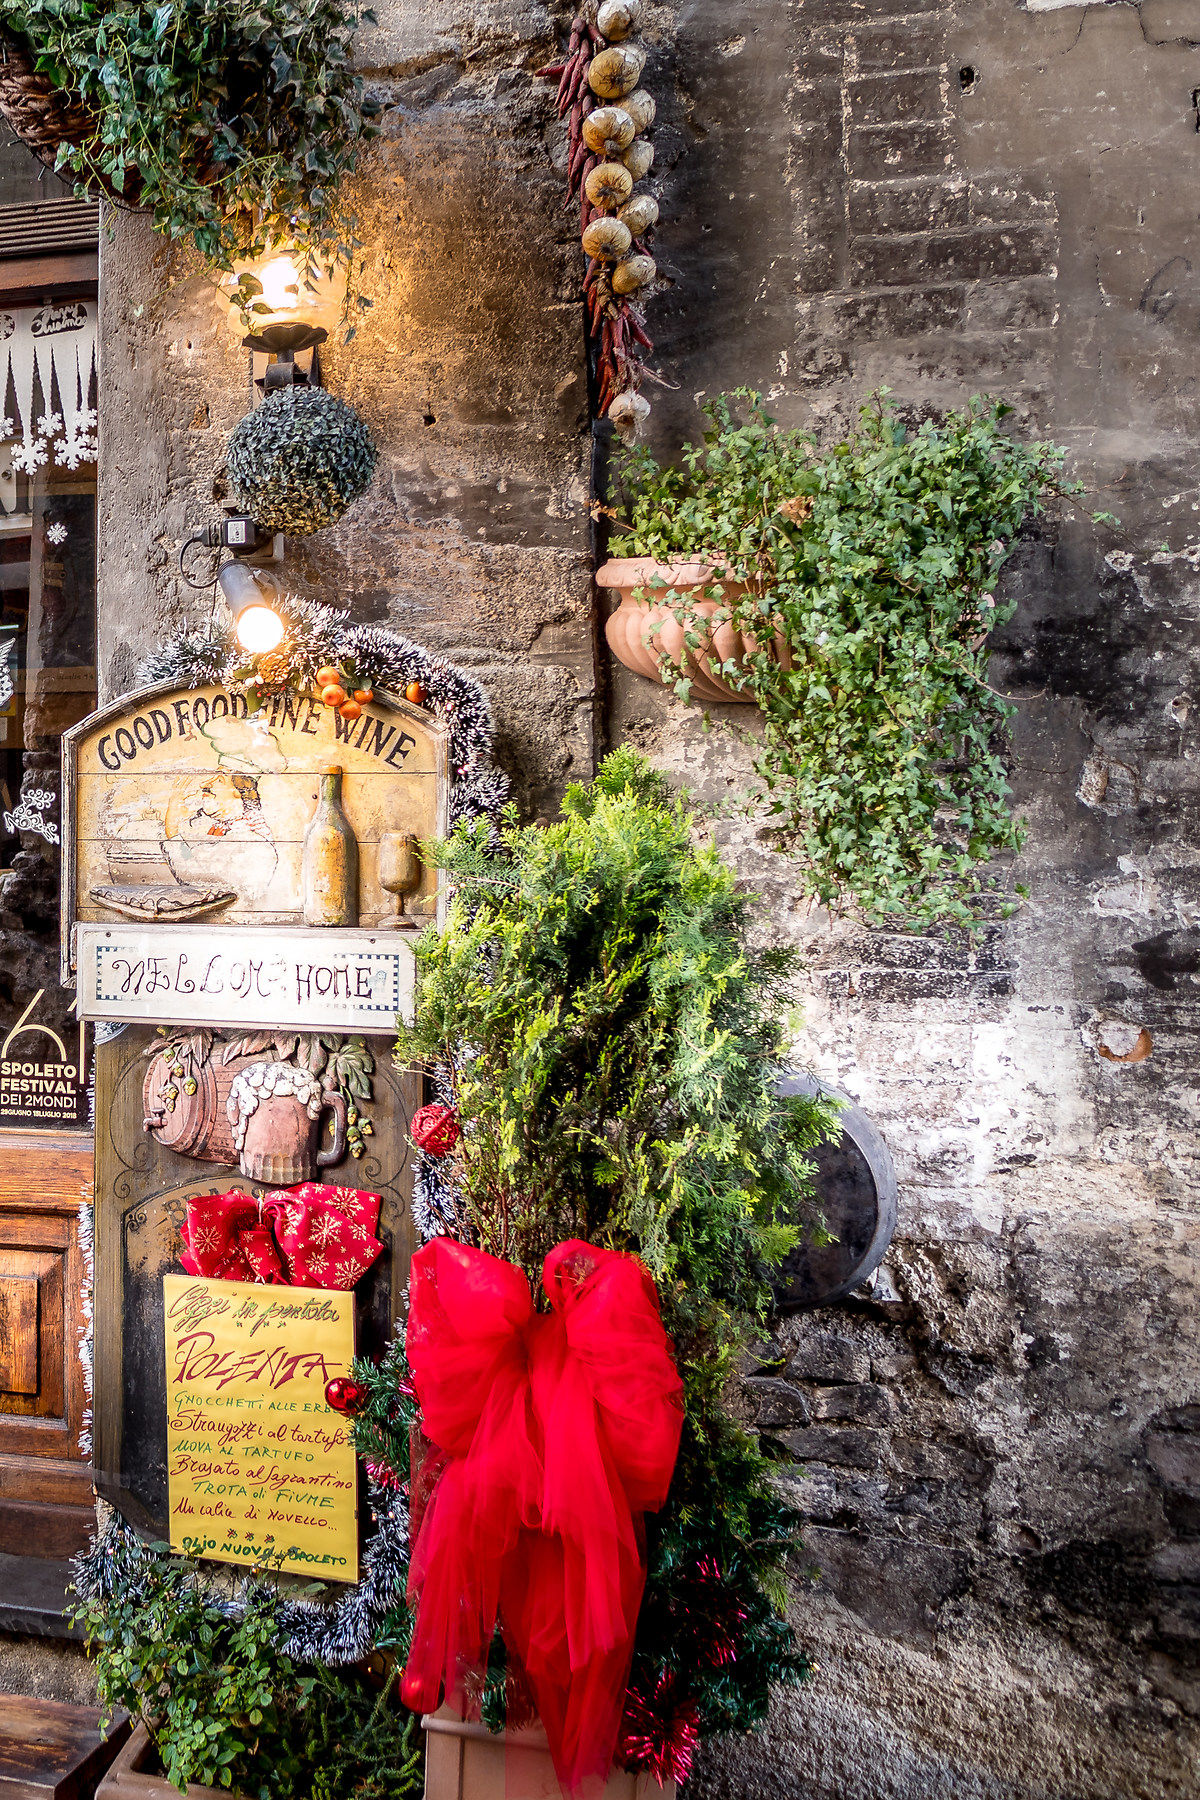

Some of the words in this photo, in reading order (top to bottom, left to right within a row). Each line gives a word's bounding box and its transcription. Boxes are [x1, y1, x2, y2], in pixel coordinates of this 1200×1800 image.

[98, 709, 172, 770] GOOD
[171, 693, 248, 736] FOOD
[266, 696, 325, 735] INE
[334, 706, 416, 770] WINE
[296, 964, 372, 1004] HOME
[1, 1061, 77, 1079] SPOLETO
[1, 1078, 76, 1095] FESTIVAL
[0, 1093, 22, 1105] DEI
[25, 1094, 77, 1109] 2MONDI
[232, 1296, 258, 1319] in
[250, 1298, 341, 1337] pentola
[173, 1331, 342, 1390] POLENTA
[268, 1402, 297, 1411] ALLE
[267, 1424, 288, 1441] al
[290, 1424, 349, 1453] tartufo
[220, 1446, 233, 1455] AL
[242, 1447, 314, 1462] TARTUFO
[170, 1454, 240, 1480] Brasato
[193, 1481, 247, 1497] TROTA
[253, 1487, 265, 1499] di
[244, 1504, 260, 1520] di
